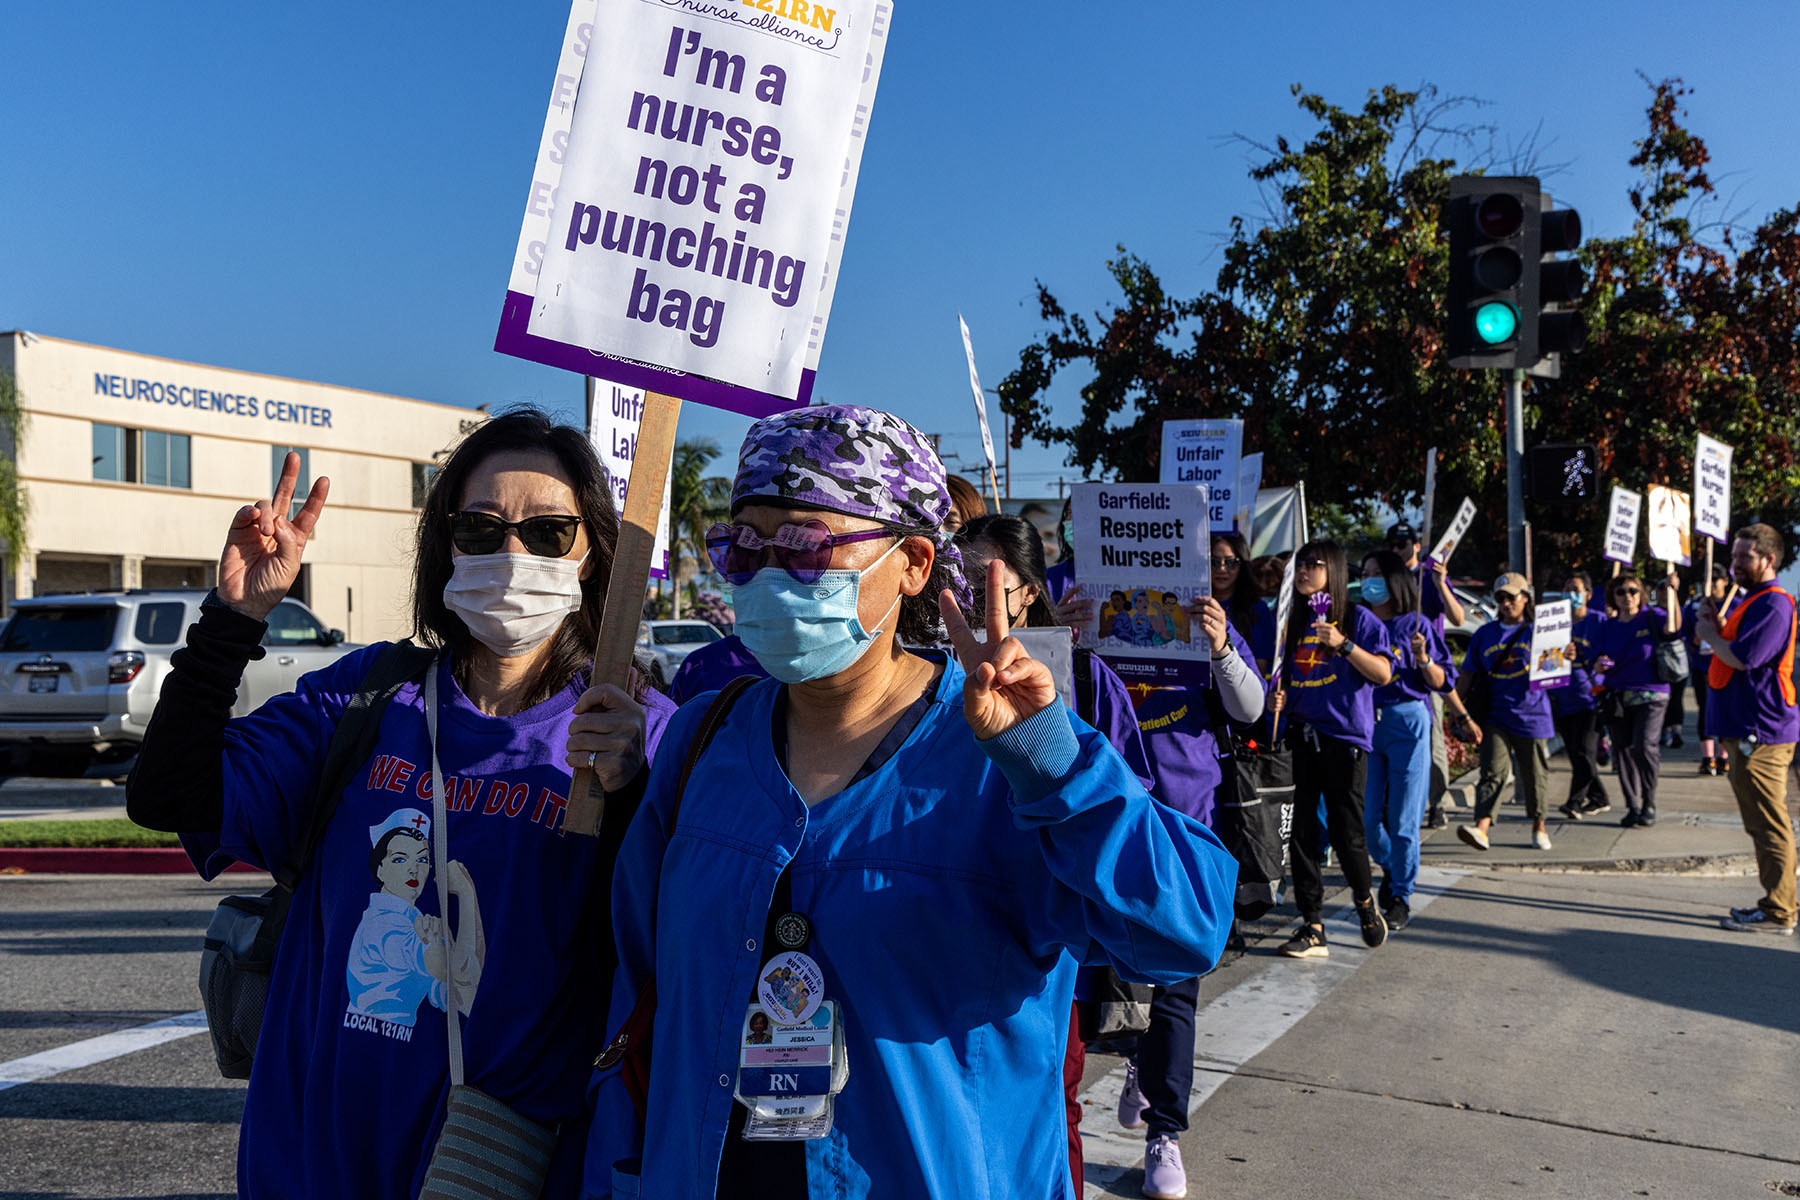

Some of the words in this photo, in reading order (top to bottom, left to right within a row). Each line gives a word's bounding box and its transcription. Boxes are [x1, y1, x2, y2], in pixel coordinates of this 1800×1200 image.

[664, 27, 745, 93] I'm
[756, 65, 786, 105] a
[628, 92, 794, 179] nurse,
[634, 157, 727, 214] not
[735, 184, 766, 224] a
[566, 202, 805, 306] punching
[627, 268, 725, 347] bag
[95, 373, 259, 417] NEUROSCIENCES
[265, 400, 332, 428] CENTER
[1177, 446, 1224, 462] Unfair
[1178, 466, 1222, 482] Labor
[1098, 491, 1170, 510] Garfield:
[1101, 516, 1184, 542] Respect
[1101, 545, 1181, 568] Nurses!
[367, 755, 416, 793] WE
[416, 771, 485, 812] CAN
[482, 780, 530, 817] DO
[786, 958, 800, 972] BUT
[802, 973, 819, 996] WILL!
[343, 1013, 379, 1033] LOCAL
[380, 1021, 413, 1042] 121RN
[769, 1073, 799, 1092] RN
